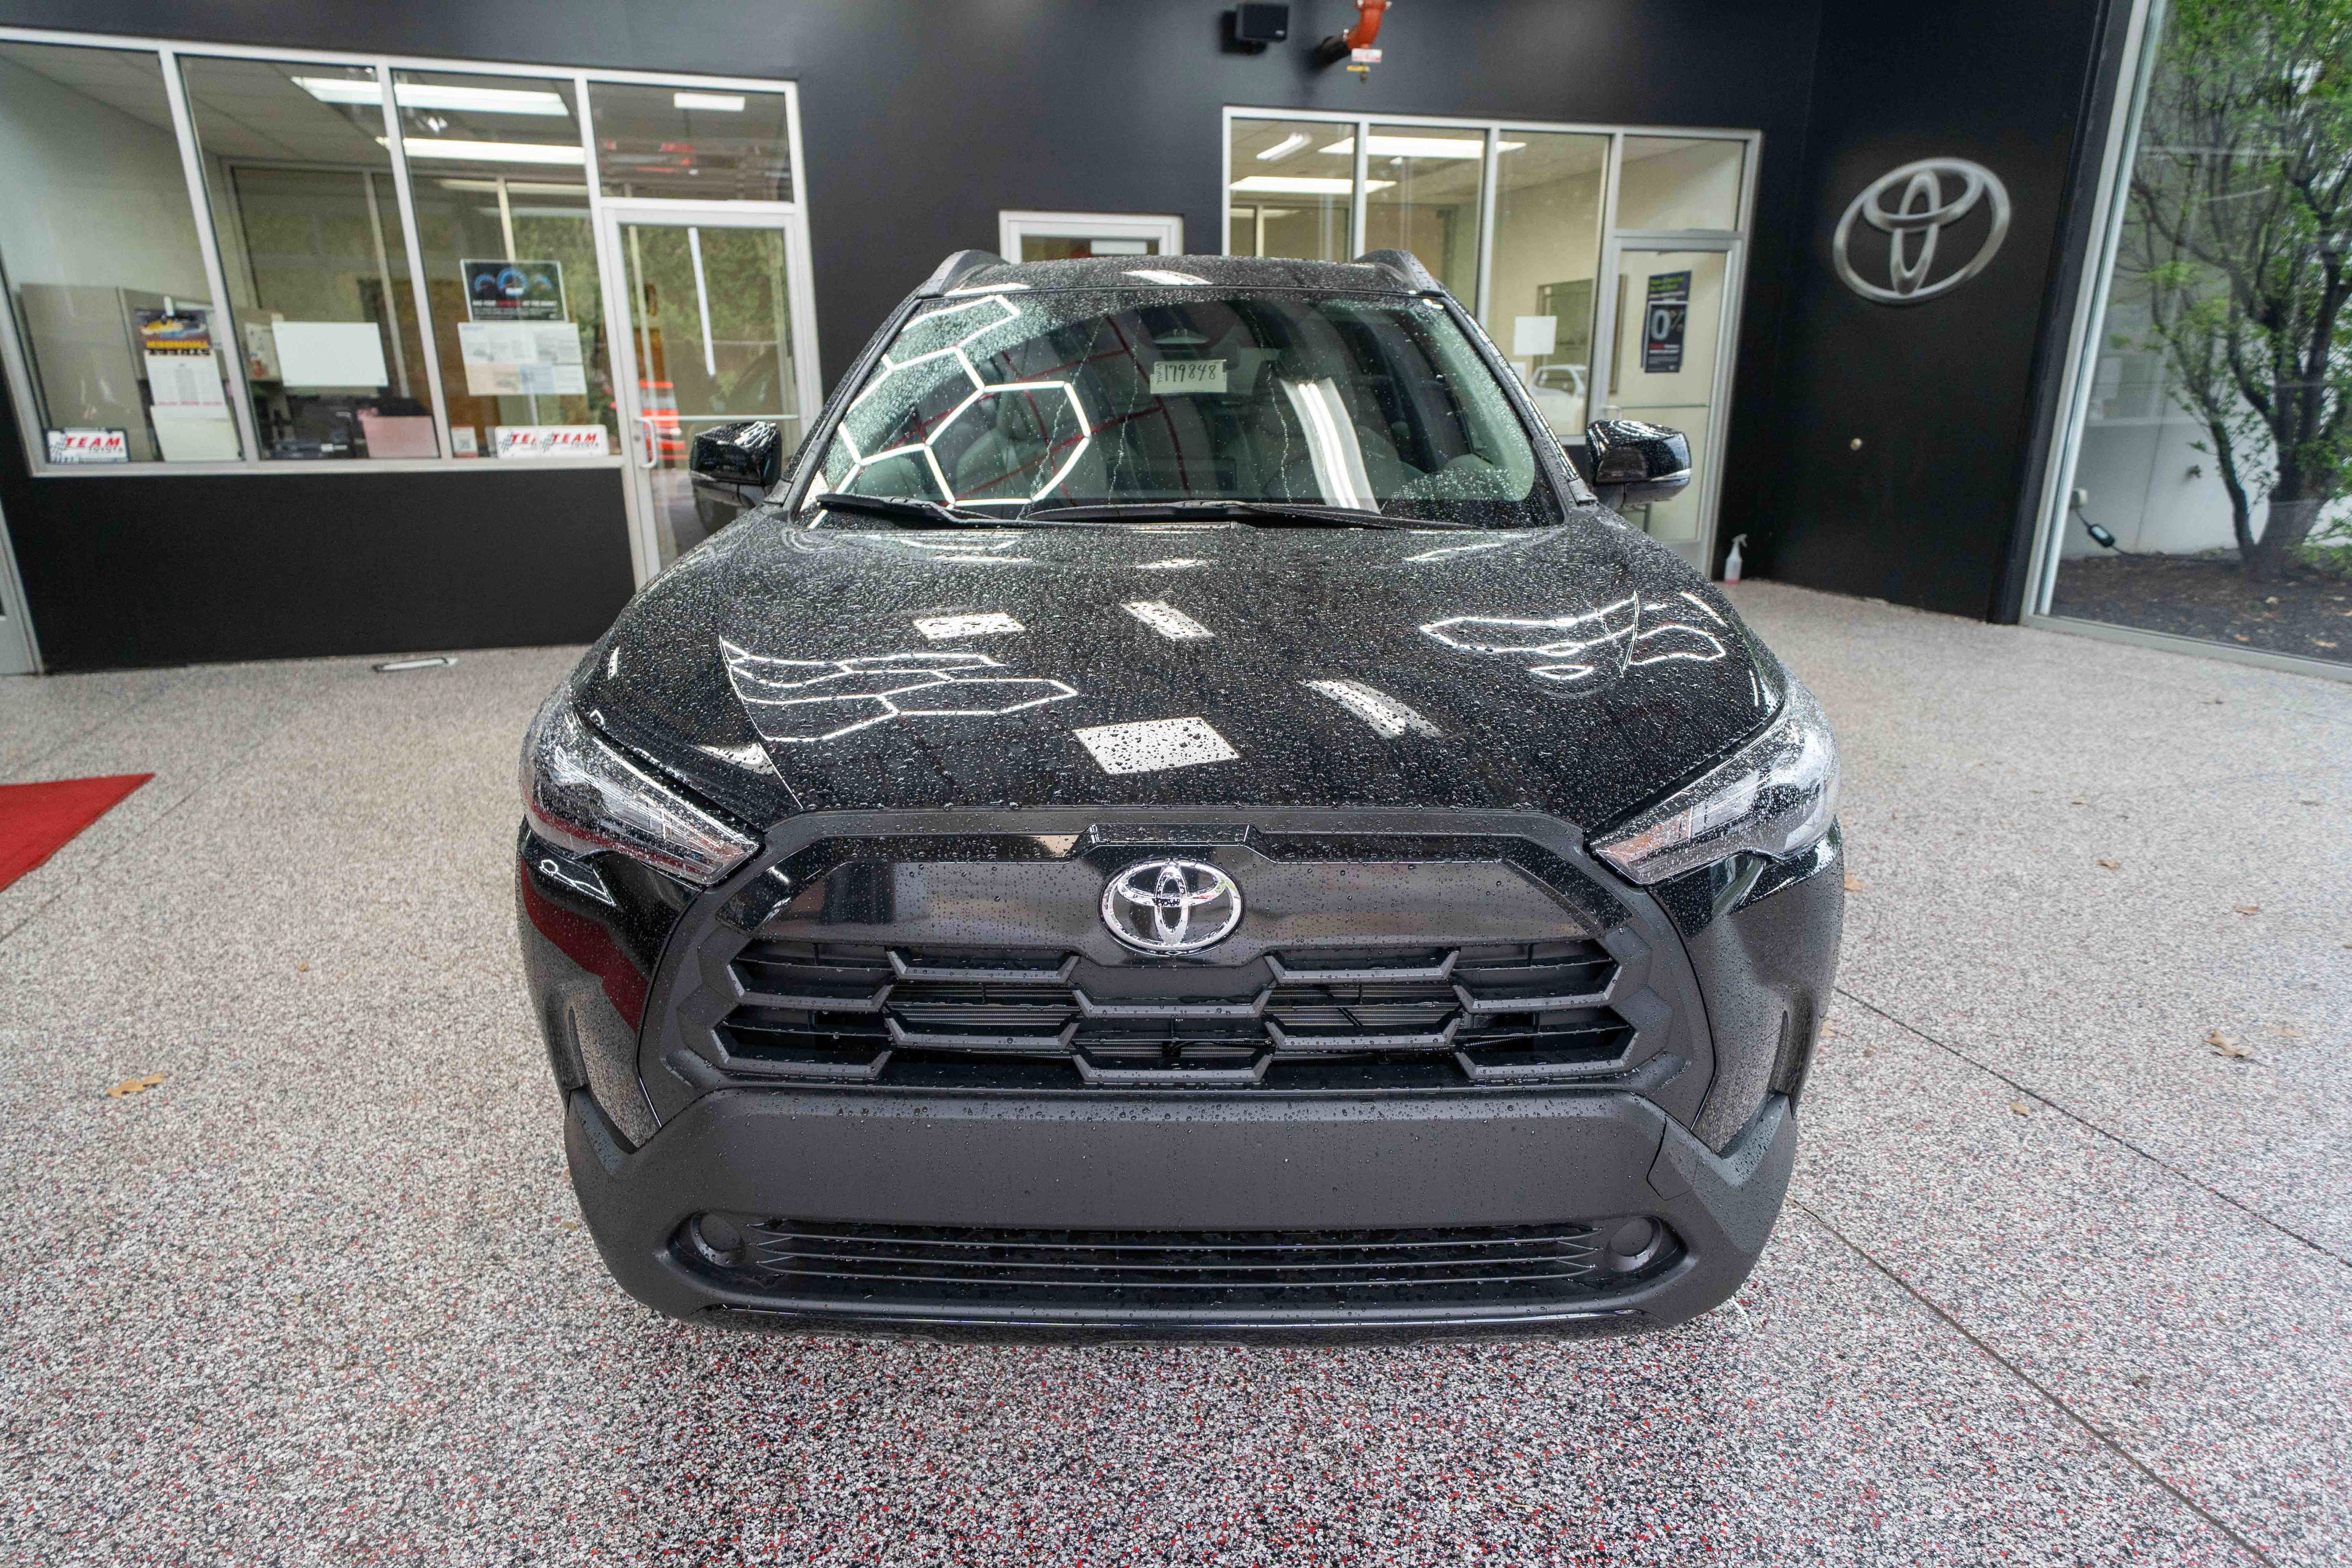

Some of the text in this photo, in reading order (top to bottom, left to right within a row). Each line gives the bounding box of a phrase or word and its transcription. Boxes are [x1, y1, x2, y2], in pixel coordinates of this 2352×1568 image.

[1165, 363, 1216, 382] 179848
[66, 437, 121, 448] TEAM
[552, 433, 597, 444] TEAM
